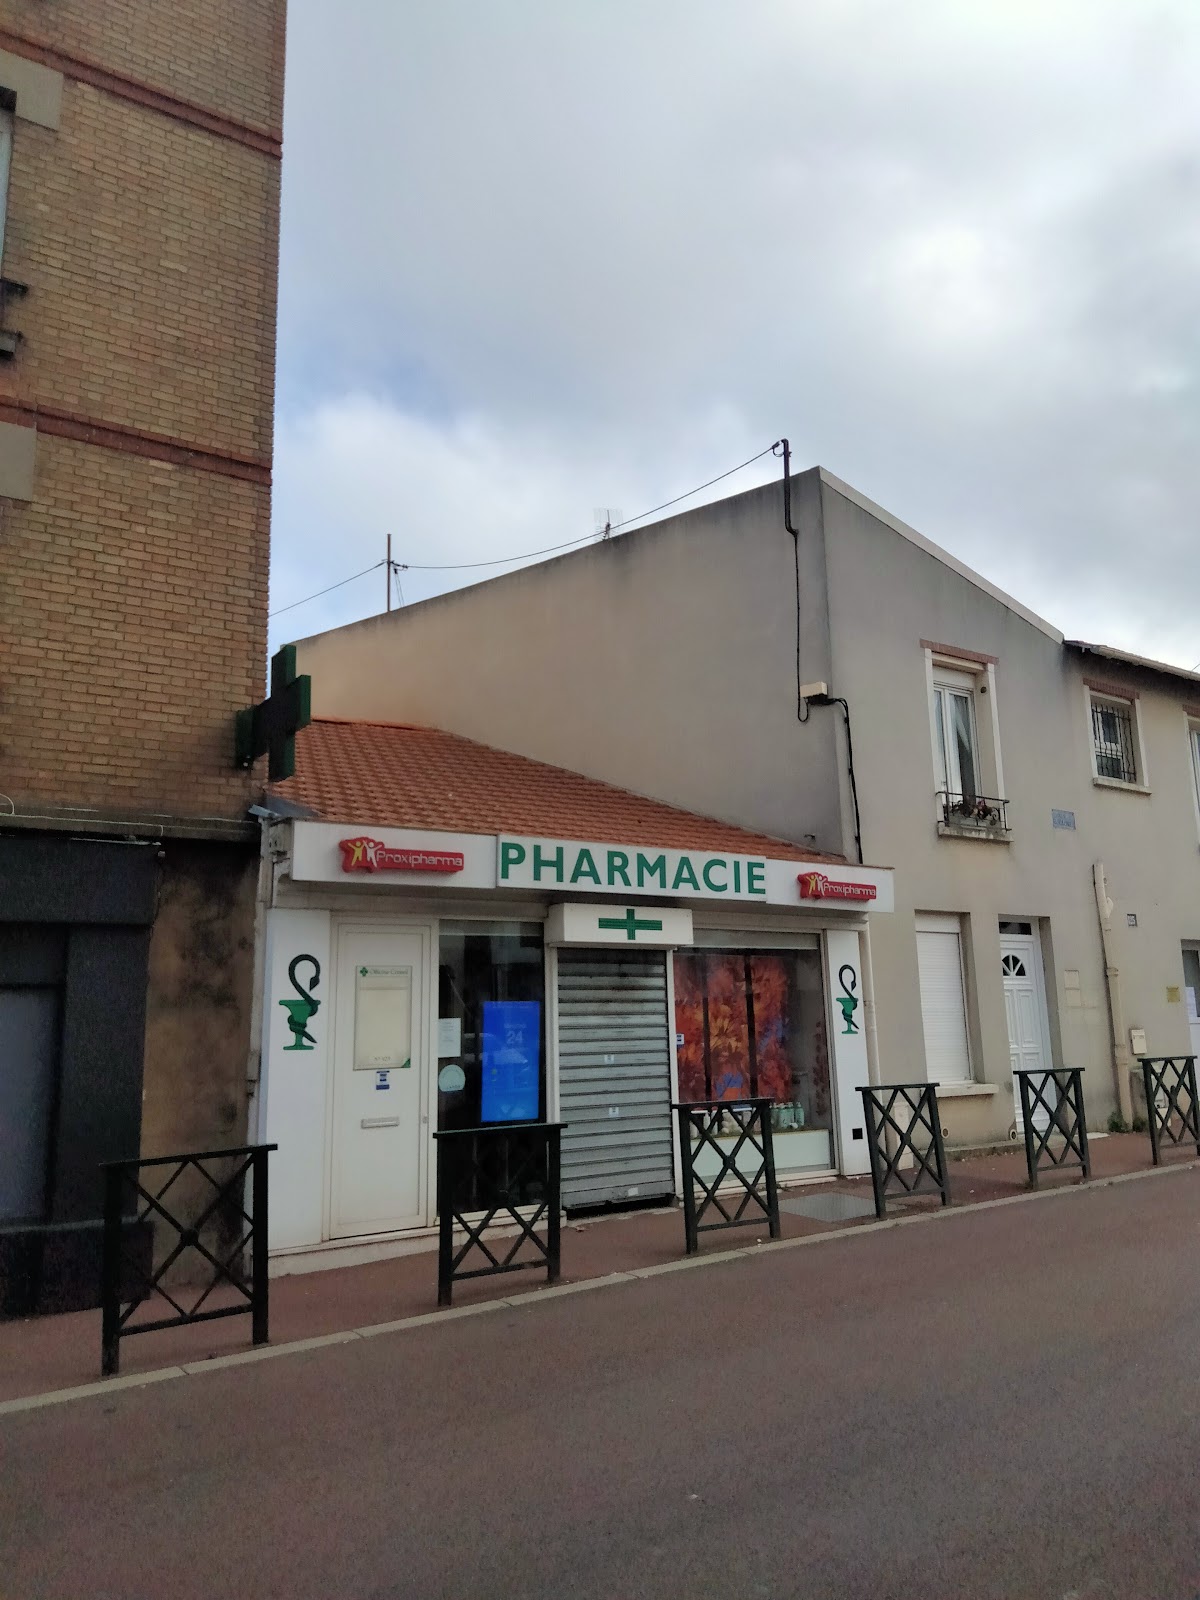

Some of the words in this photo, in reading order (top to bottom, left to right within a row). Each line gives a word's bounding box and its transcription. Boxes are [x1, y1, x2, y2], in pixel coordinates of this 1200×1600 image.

[376, 851, 463, 867] Proxipharma
[501, 842, 766, 894] PHARMACIE
[824, 883, 876, 896] Proxipharma
[506, 1030, 524, 1044] 24
